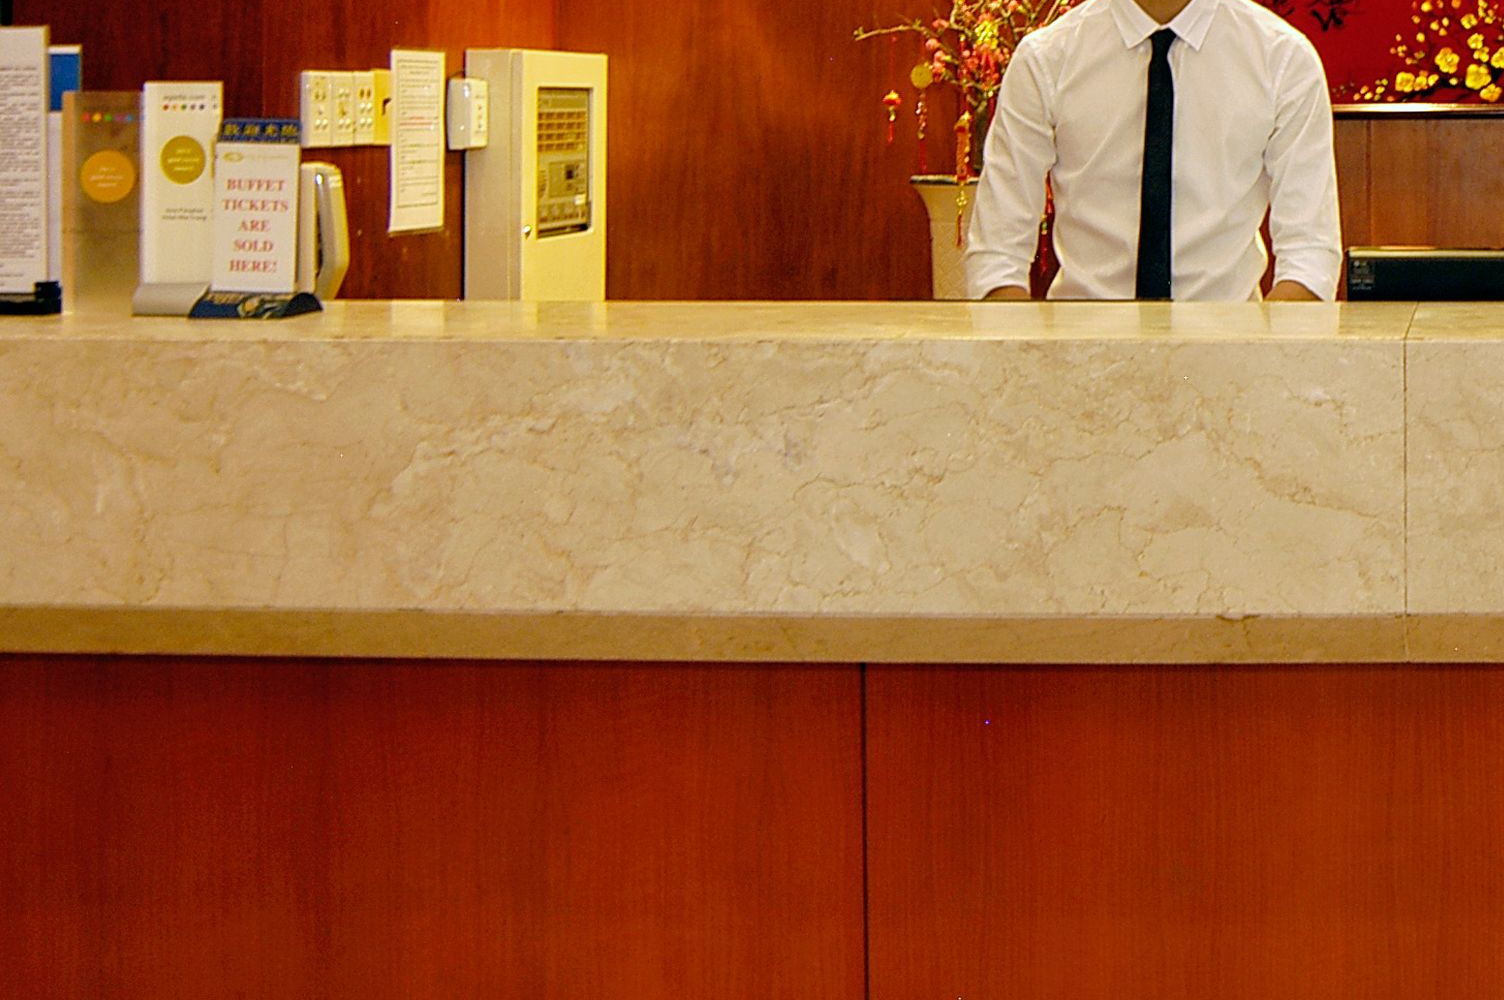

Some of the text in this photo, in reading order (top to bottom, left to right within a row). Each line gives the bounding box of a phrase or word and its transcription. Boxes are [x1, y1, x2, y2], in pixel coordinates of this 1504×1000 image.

[226, 178, 285, 191] BUFFET
[223, 198, 289, 211] TICKETS
[238, 219, 271, 232] ARE
[233, 239, 273, 252] SOLD
[229, 259, 278, 273] HERE!
